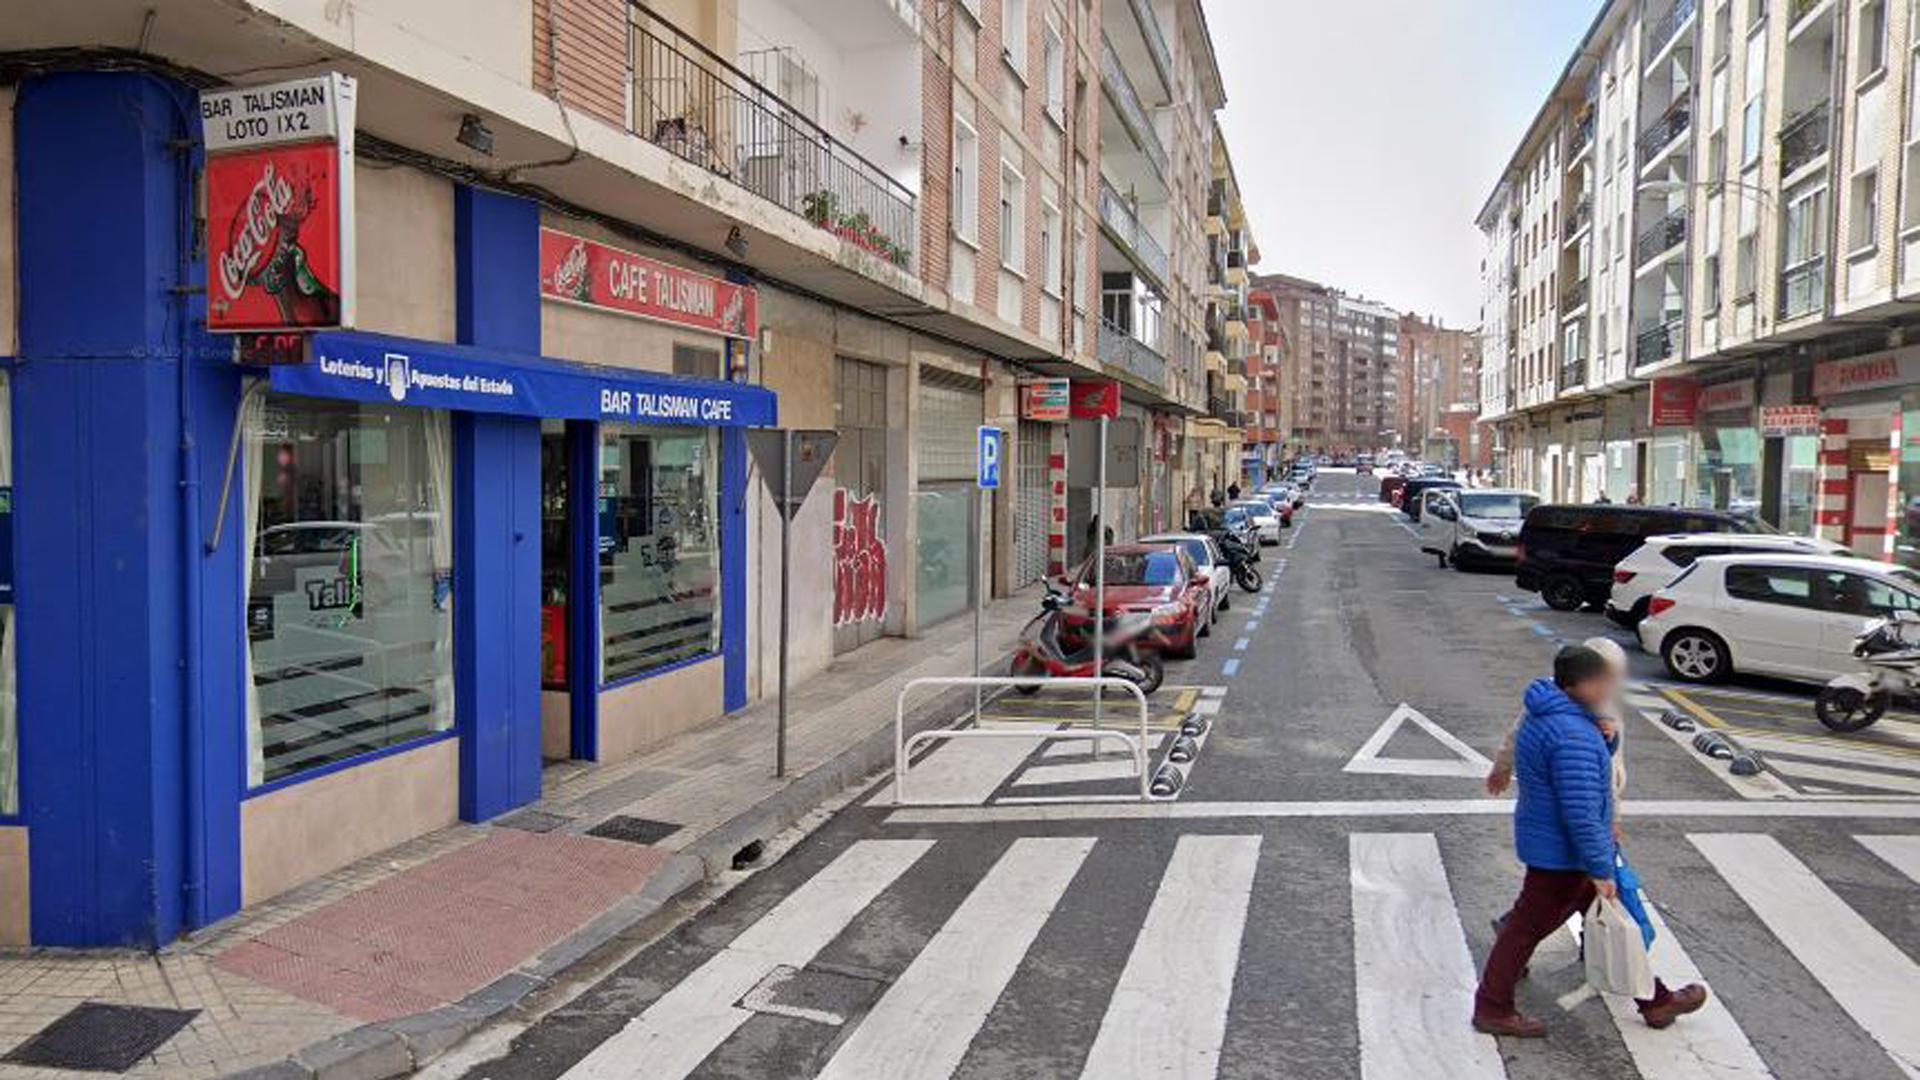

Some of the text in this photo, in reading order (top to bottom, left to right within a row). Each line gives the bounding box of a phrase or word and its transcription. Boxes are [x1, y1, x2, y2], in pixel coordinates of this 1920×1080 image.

[202, 86, 325, 119] BAR TALISMAN
[226, 117, 268, 140] LOTO
[609, 260, 647, 304] CAFE
[654, 270, 714, 318] TALISMAN
[376, 367, 384, 384] y
[412, 369, 461, 390] Apuestas
[463, 375, 479, 391] del
[481, 378, 513, 395] Estado
[601, 389, 732, 420] BAR TALISMAN CAFE
[984, 436, 997, 480] P
